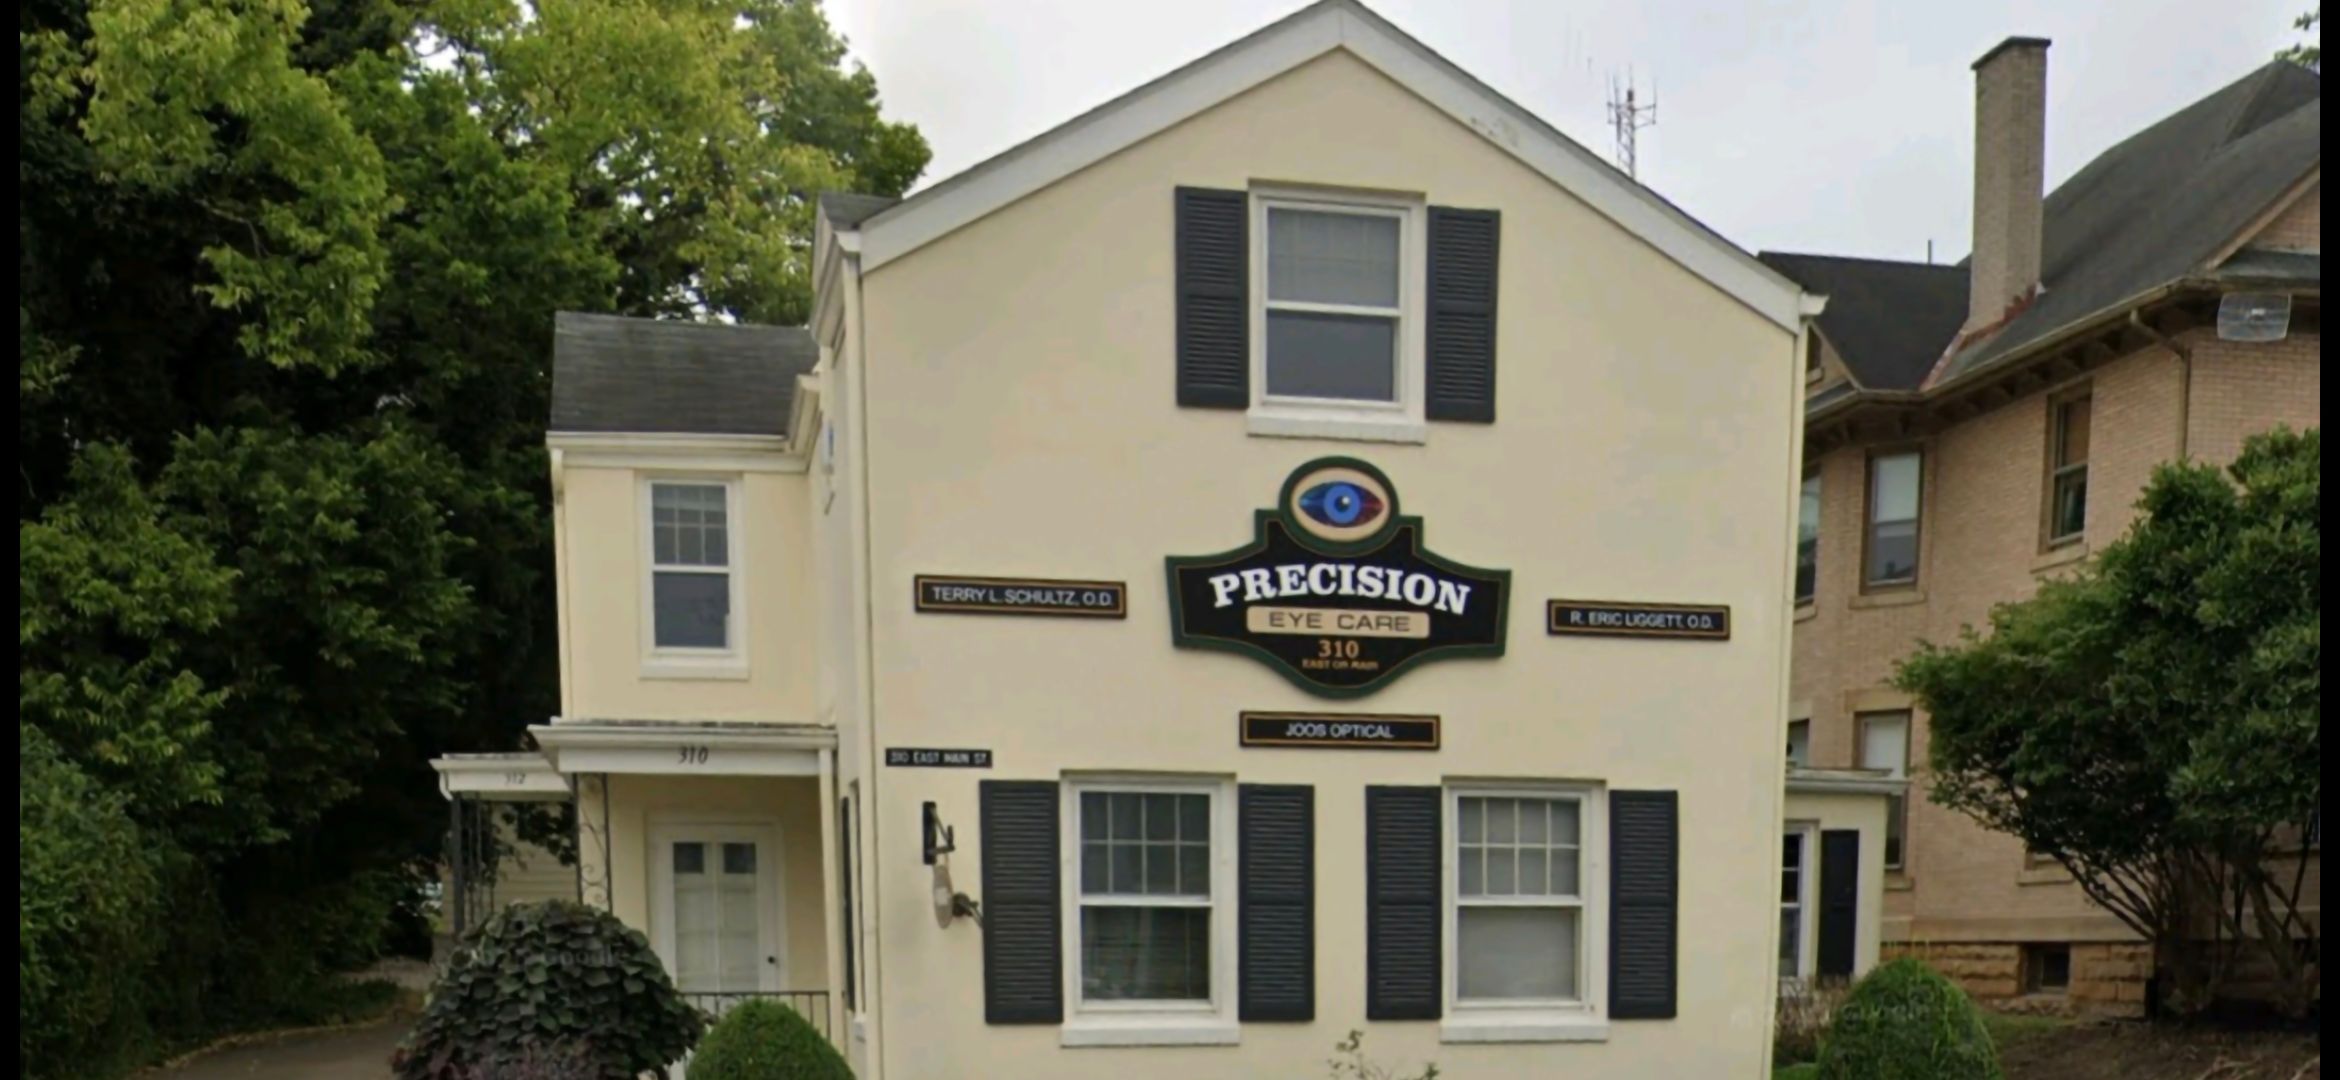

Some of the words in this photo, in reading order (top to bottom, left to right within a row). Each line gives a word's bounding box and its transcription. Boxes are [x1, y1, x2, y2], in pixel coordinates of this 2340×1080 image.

[931, 586, 985, 601] TERRY
[1004, 588, 1080, 606] SCHULTZ,
[1208, 563, 1471, 615] PRECISION
[1269, 611, 1322, 629] EYE
[1337, 614, 1411, 632] CARE
[1569, 610, 1584, 624] R.
[1588, 611, 1623, 625] ERIC
[1318, 638, 1360, 659] 310
[1286, 722, 1326, 737] JOOS
[1329, 723, 1394, 738] OPTICAL
[678, 746, 709, 765] 310
[913, 751, 939, 764] EAST
[943, 752, 970, 764] MAIN
